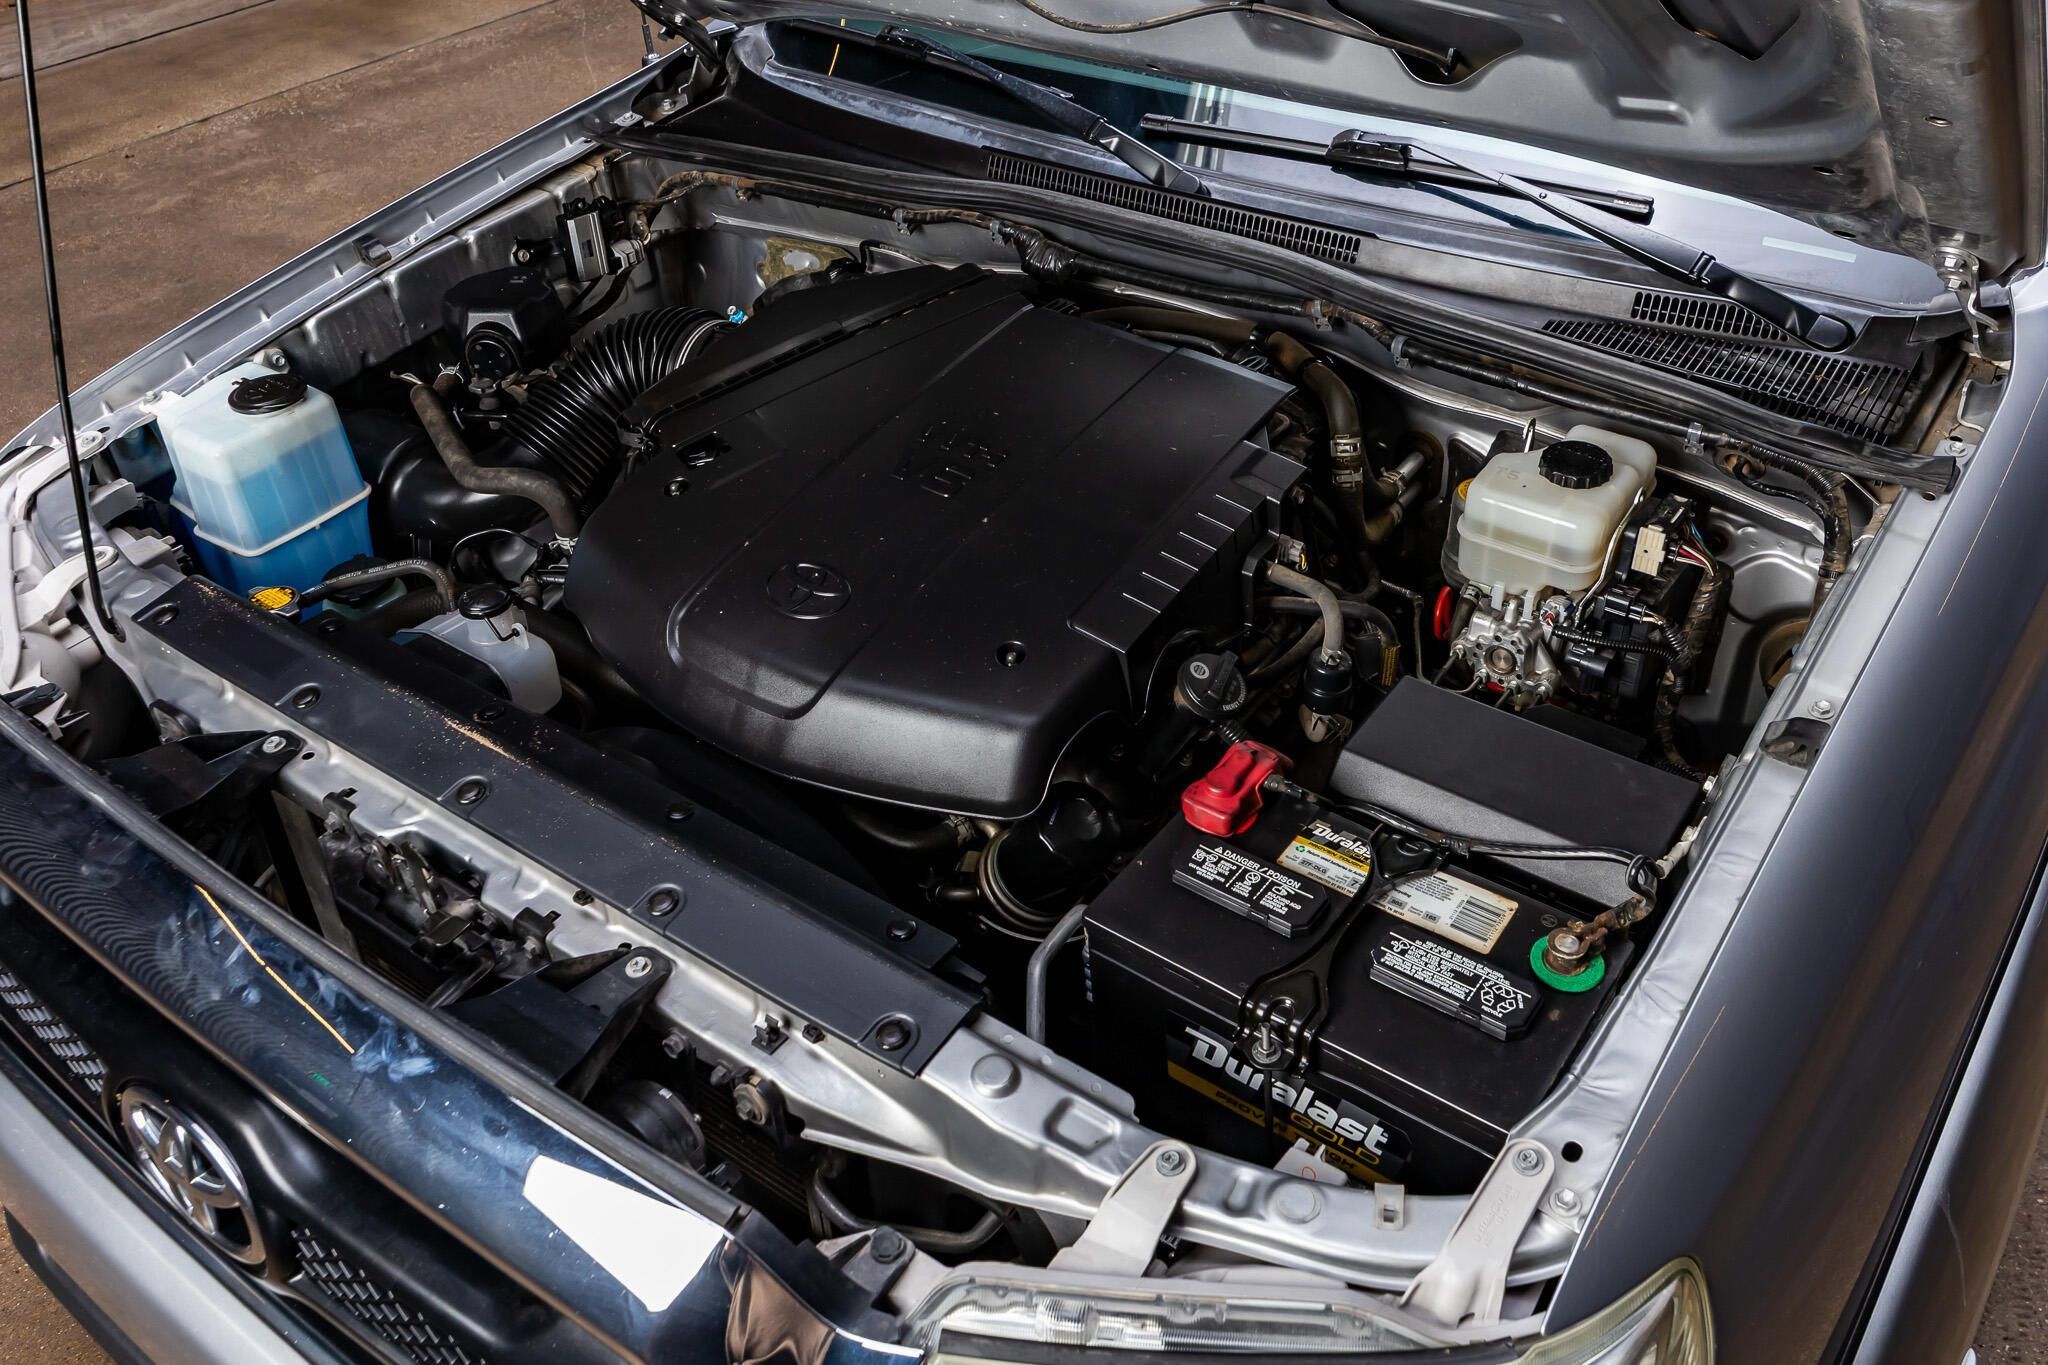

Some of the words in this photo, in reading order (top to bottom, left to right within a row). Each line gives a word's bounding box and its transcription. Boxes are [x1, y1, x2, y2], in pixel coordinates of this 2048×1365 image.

[1308, 840, 1338, 857] PROVEN
[1312, 823, 1371, 858] Duralas
[1222, 849, 1261, 870] DANGER
[1265, 869, 1301, 889] POISON
[1403, 953, 1427, 966] MEDICAL
[1425, 963, 1441, 972] HELP
[1439, 969, 1454, 978] FAST
[1409, 945, 1427, 956] FLUSH
[1425, 952, 1441, 962] EYES
[1439, 958, 1474, 976] IMMEDIATELY
[1185, 1027, 1388, 1156] Duralast
[1215, 1090, 1286, 1132] PROVN
[1290, 1111, 1380, 1165] GOLD
